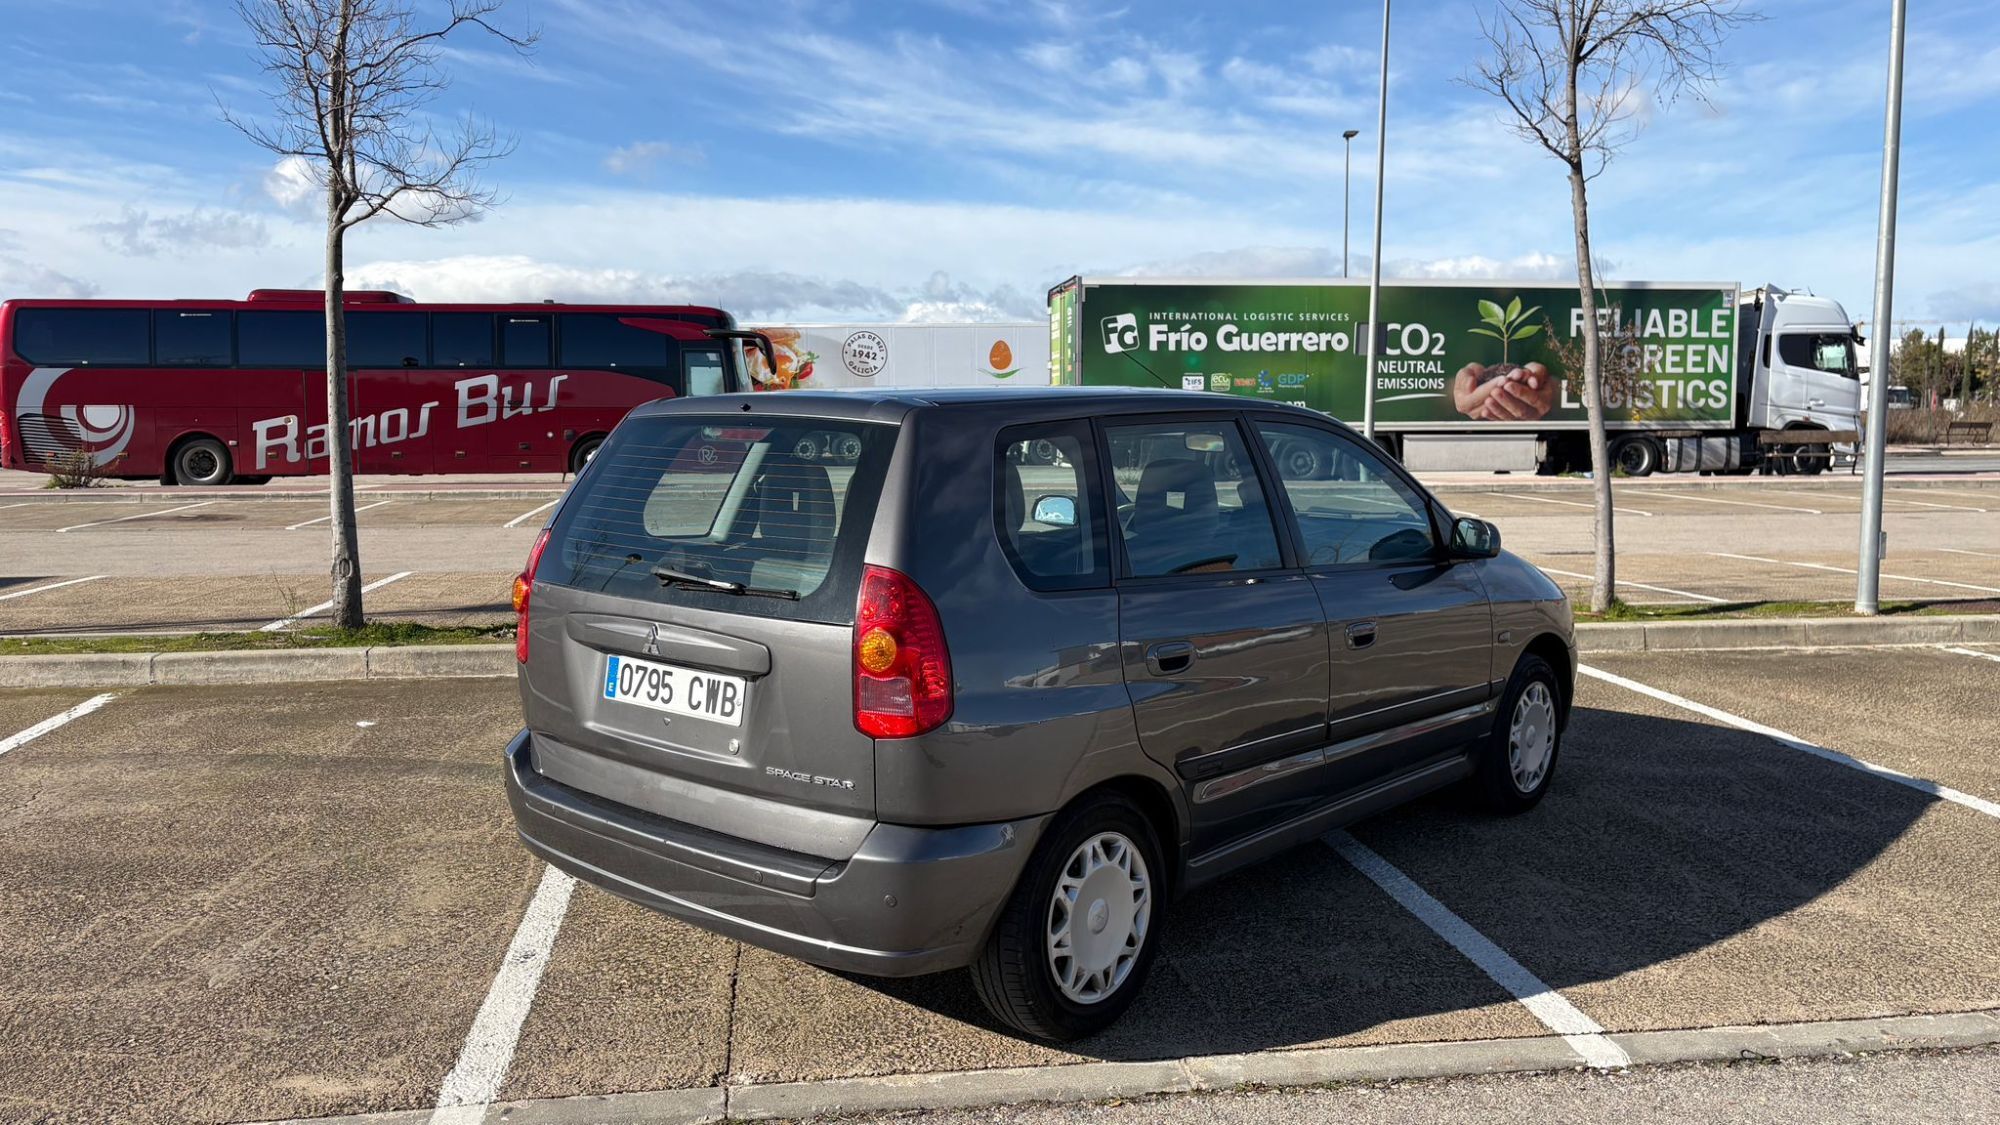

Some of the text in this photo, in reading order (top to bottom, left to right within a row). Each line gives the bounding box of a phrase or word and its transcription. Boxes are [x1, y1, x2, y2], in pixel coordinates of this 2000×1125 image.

[1149, 312, 1349, 321] INTERNATIONAL LOGISTIC SERVICES
[1149, 323, 1350, 352] Frío Guerrero
[851, 348, 878, 361] 1942
[848, 360, 879, 374] GALICIA
[1377, 360, 1445, 374] NEUTRAL
[1278, 374, 1306, 385] GDP
[1377, 378, 1445, 389] EMISSIONS
[454, 374, 569, 429] Bus
[608, 682, 614, 692] E
[619, 663, 738, 718] 0795 CWB
[766, 766, 856, 791] SPACE STAR
